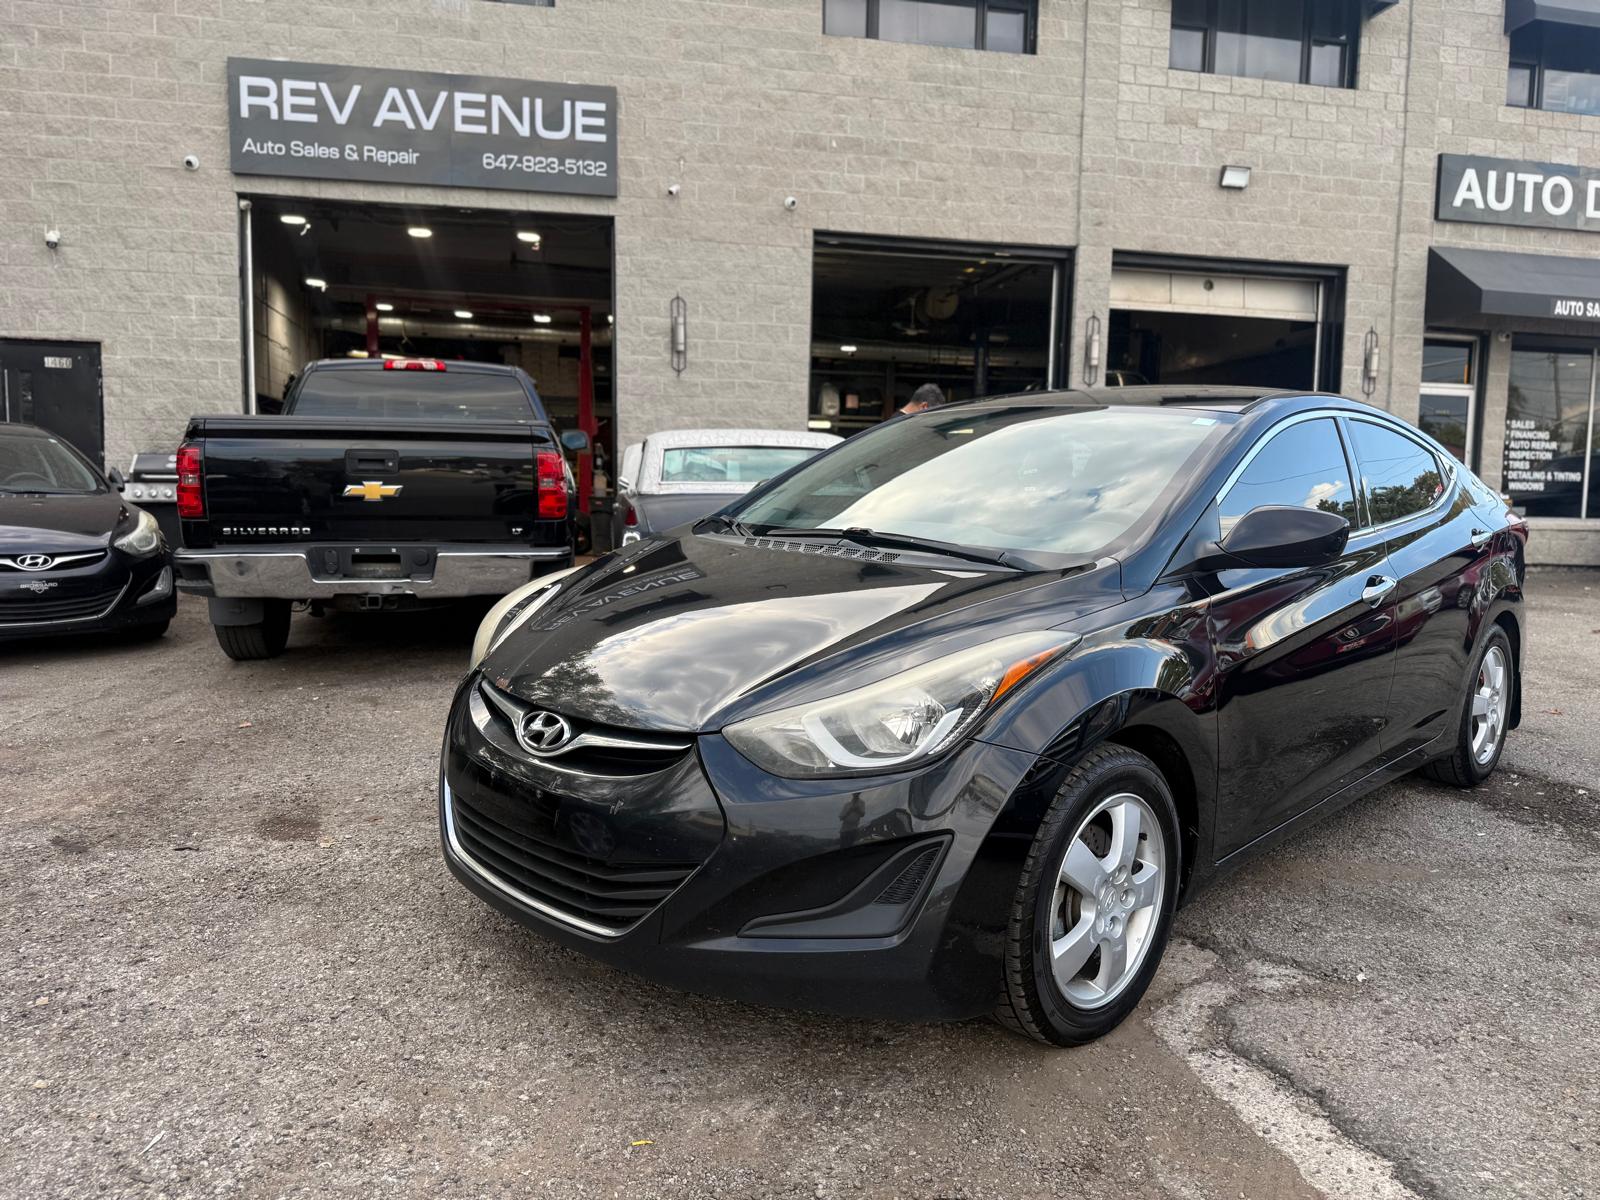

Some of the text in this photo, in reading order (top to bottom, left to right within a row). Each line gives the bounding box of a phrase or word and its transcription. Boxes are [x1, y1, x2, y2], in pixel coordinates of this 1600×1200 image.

[239, 75, 607, 143] REV AVENUE
[242, 138, 420, 166] Auto Sales & Repair
[481, 153, 608, 178] 647-823-5132
[1452, 167, 1574, 216] AUTO
[1554, 299, 1584, 317] AUTO
[1511, 420, 1535, 429] SALES
[1510, 430, 1551, 440] FINANCING
[1509, 440, 1558, 450] AUTO REPAIR
[1508, 450, 1553, 460] INSPECTION
[1508, 460, 1530, 469] TIRES
[1507, 470, 1582, 482] DETAILING & TINTING
[1508, 481, 1545, 492] WINDOWS
[222, 527, 311, 535] SILVERADO
